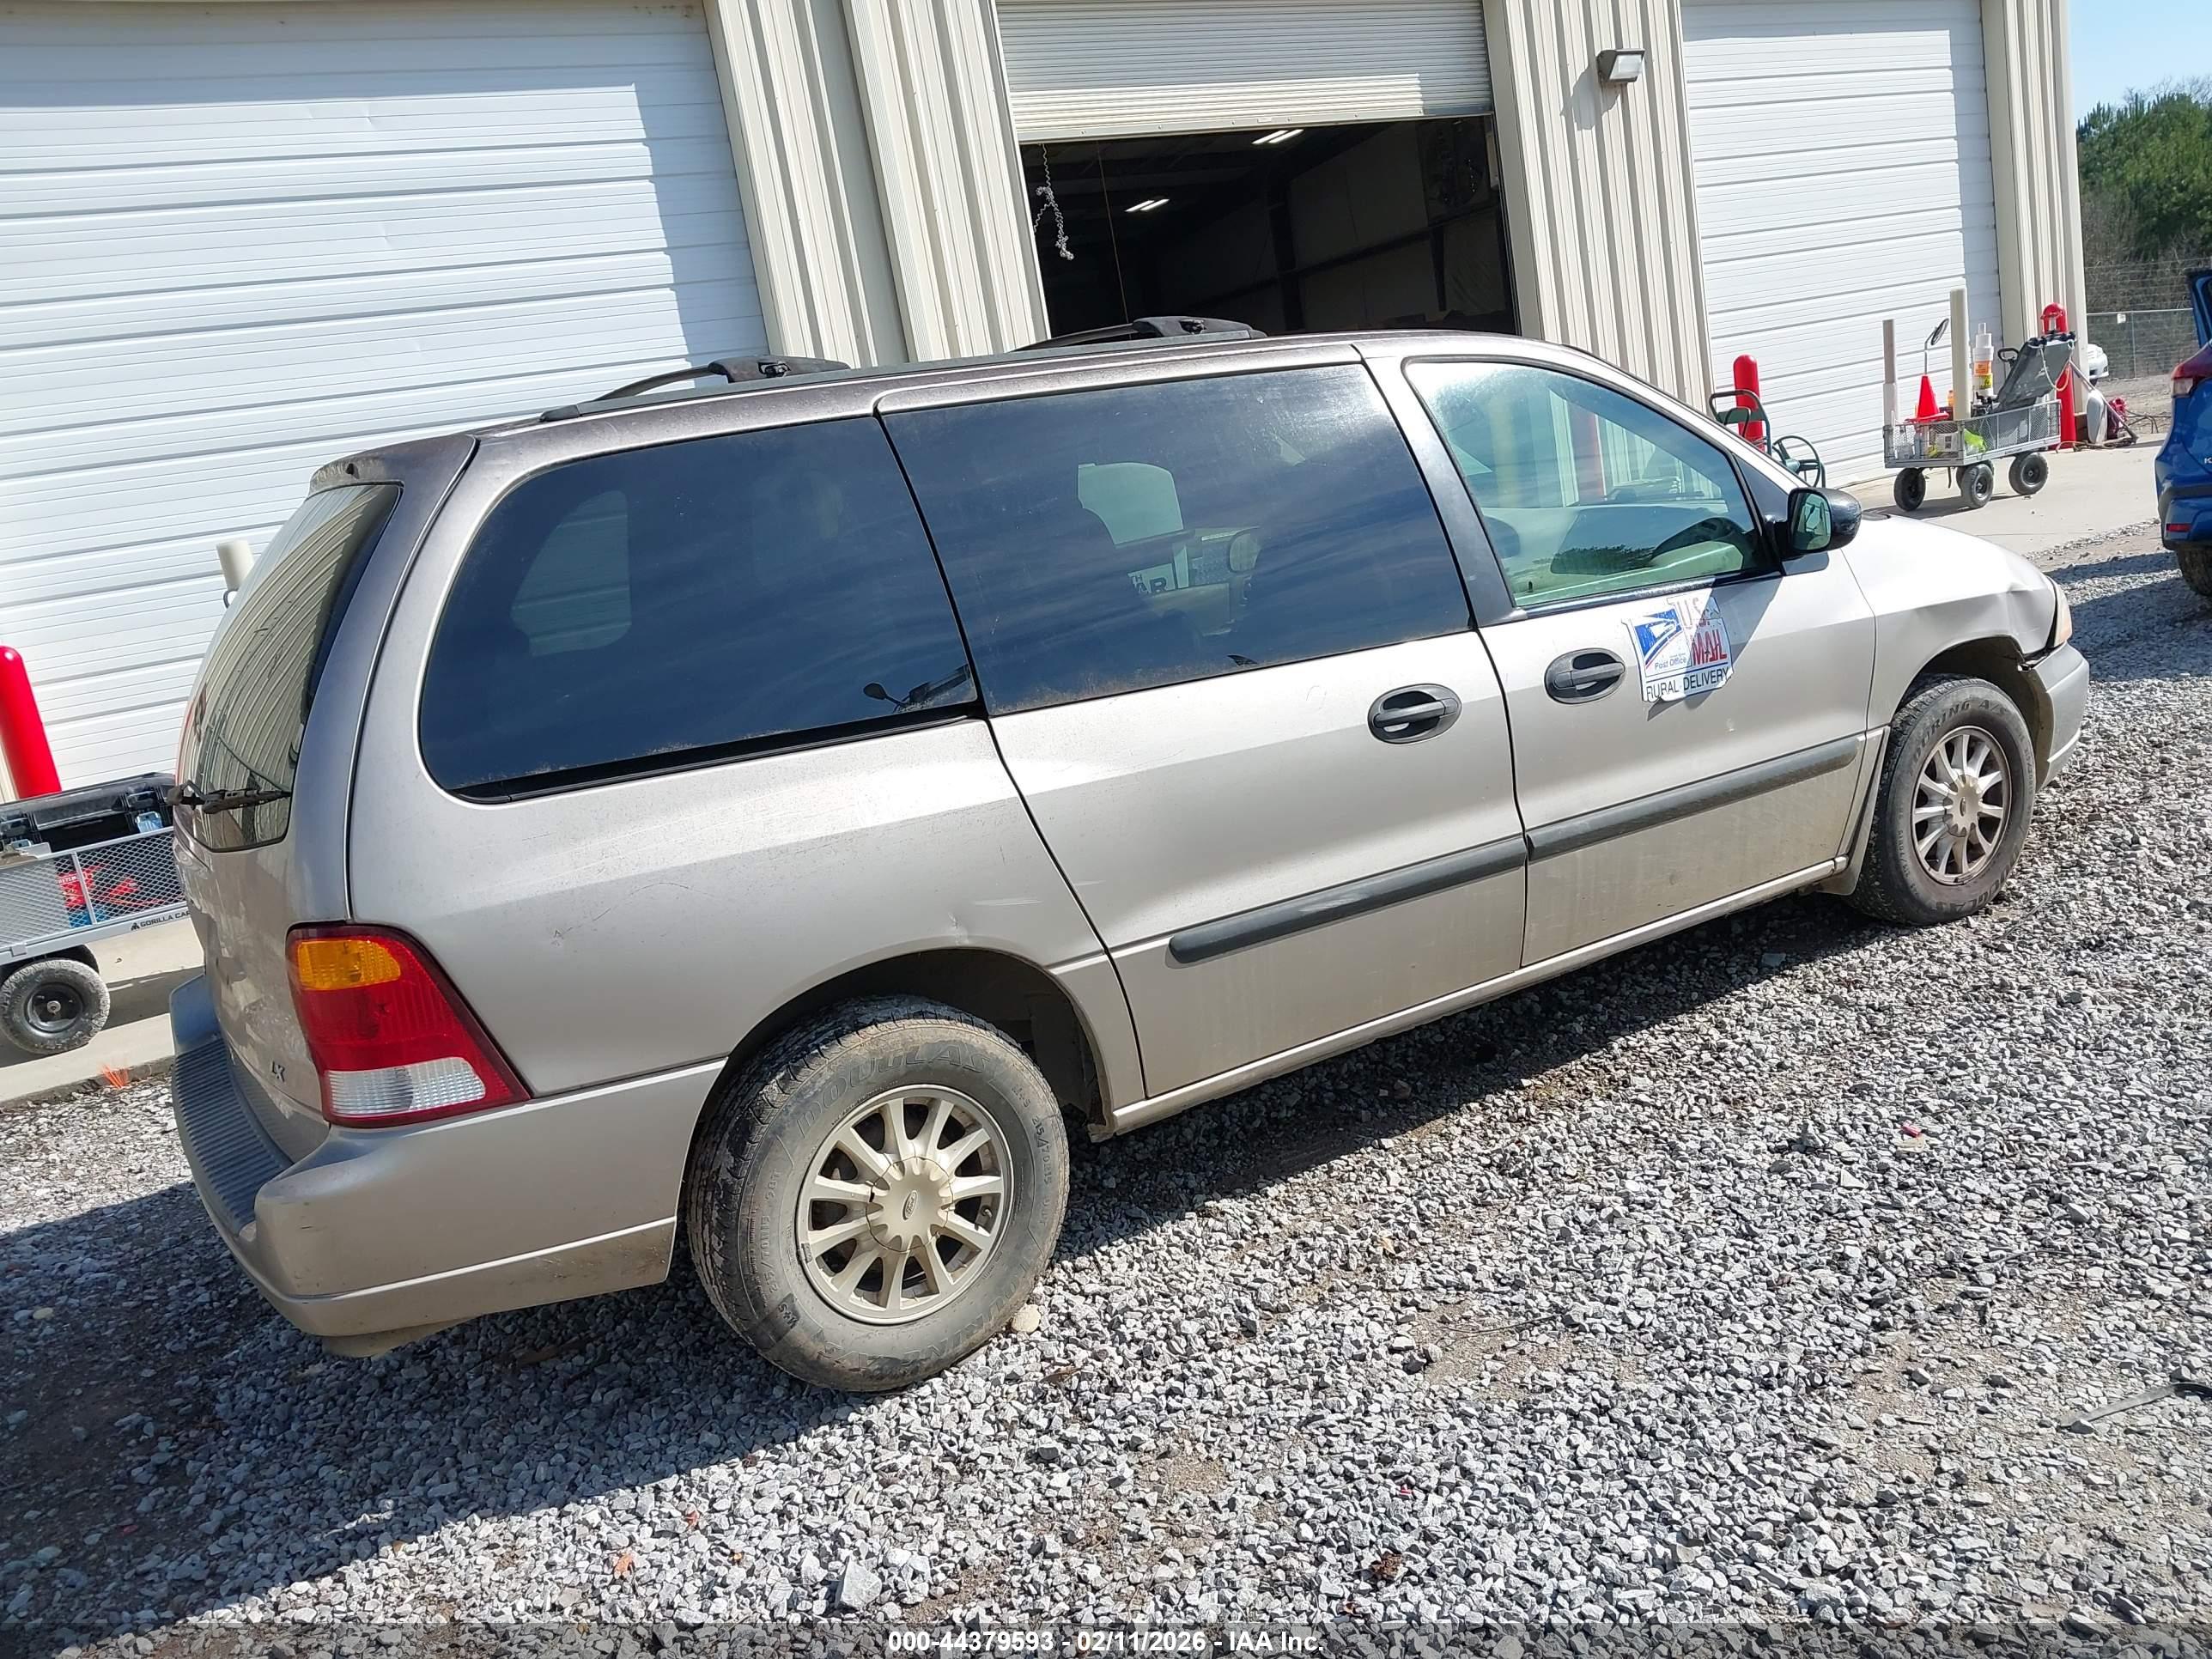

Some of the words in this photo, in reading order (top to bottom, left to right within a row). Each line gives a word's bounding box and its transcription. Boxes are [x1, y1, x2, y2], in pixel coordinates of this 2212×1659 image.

[1655, 659, 1669, 670] Post
[1669, 655, 1687, 666] Office
[1646, 679, 1680, 700] RURAL
[1683, 665, 1729, 691] DELIVERY
[140, 915, 173, 927] GORILLA
[270, 1060, 285, 1083] LX
